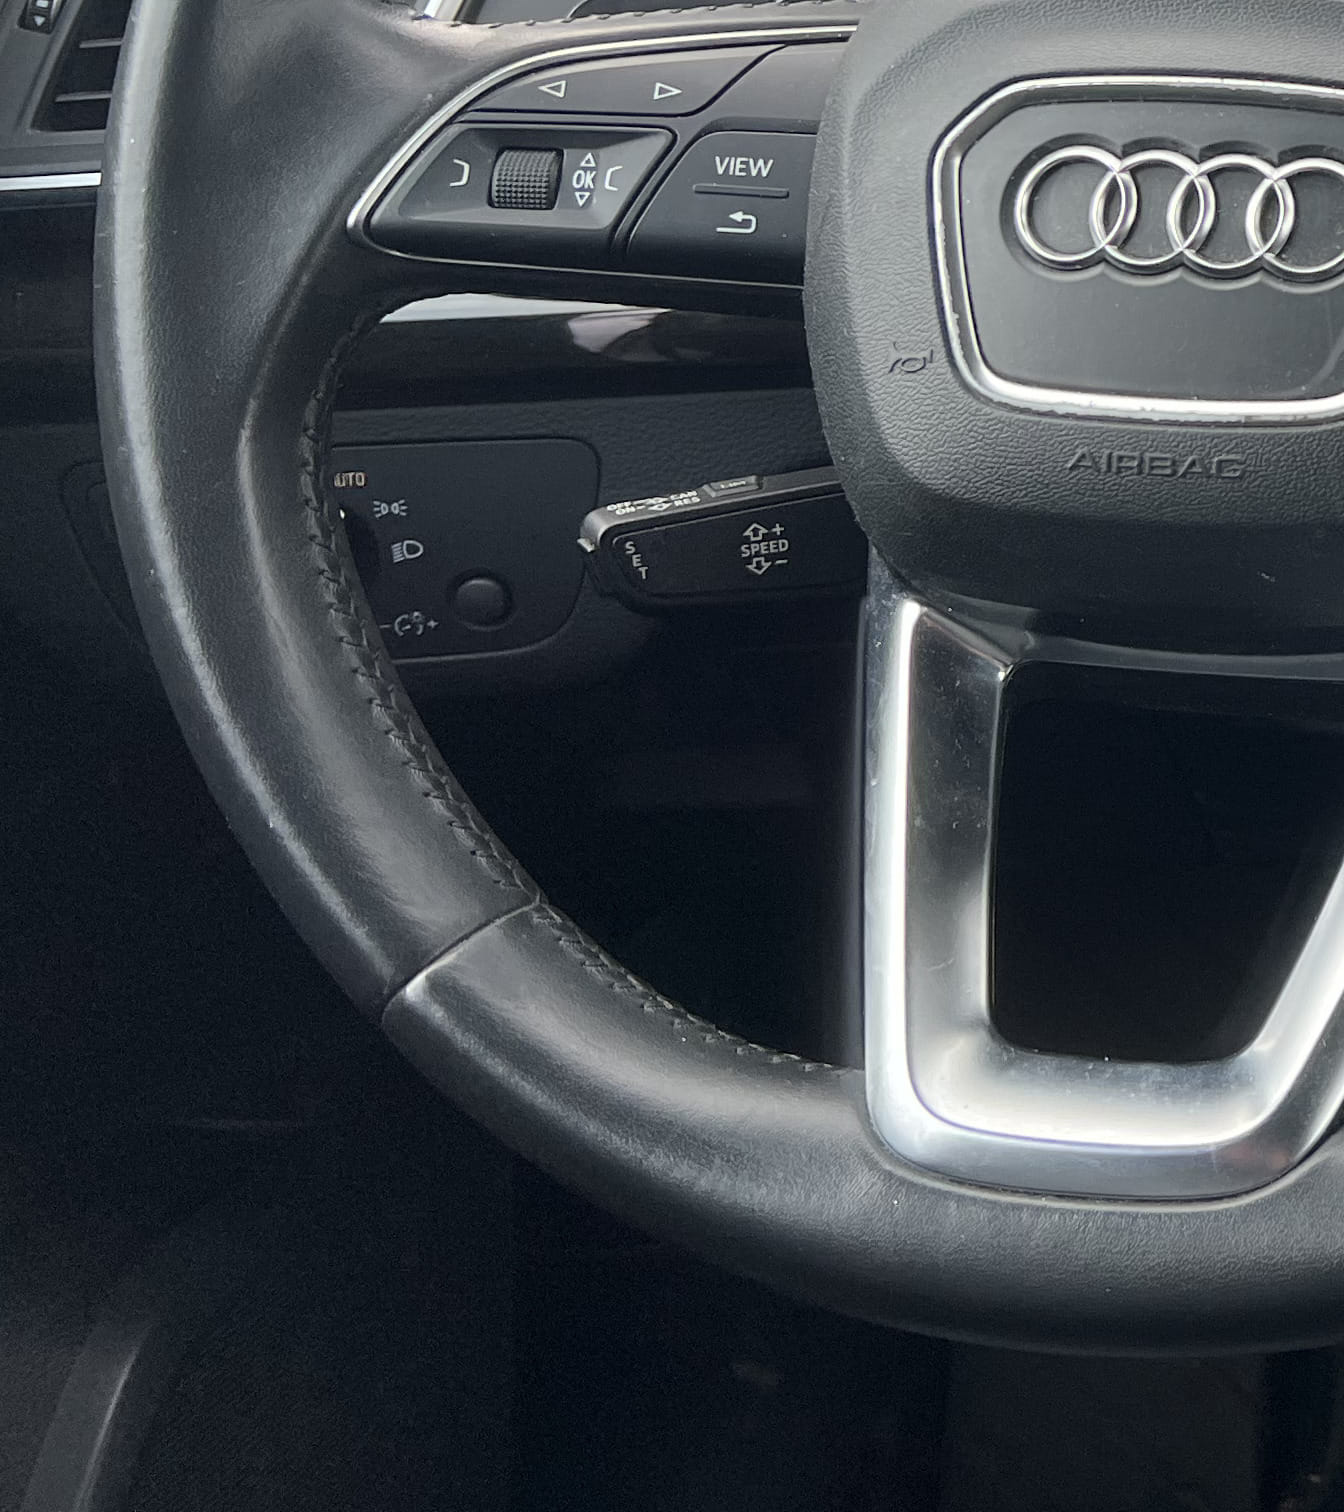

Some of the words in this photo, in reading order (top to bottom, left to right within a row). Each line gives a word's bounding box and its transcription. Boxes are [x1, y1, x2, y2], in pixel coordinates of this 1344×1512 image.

[714, 157, 774, 178] VIEW
[572, 169, 596, 189] OK
[1066, 449, 1249, 479] AIRBAG
[741, 539, 789, 558] SPEED
